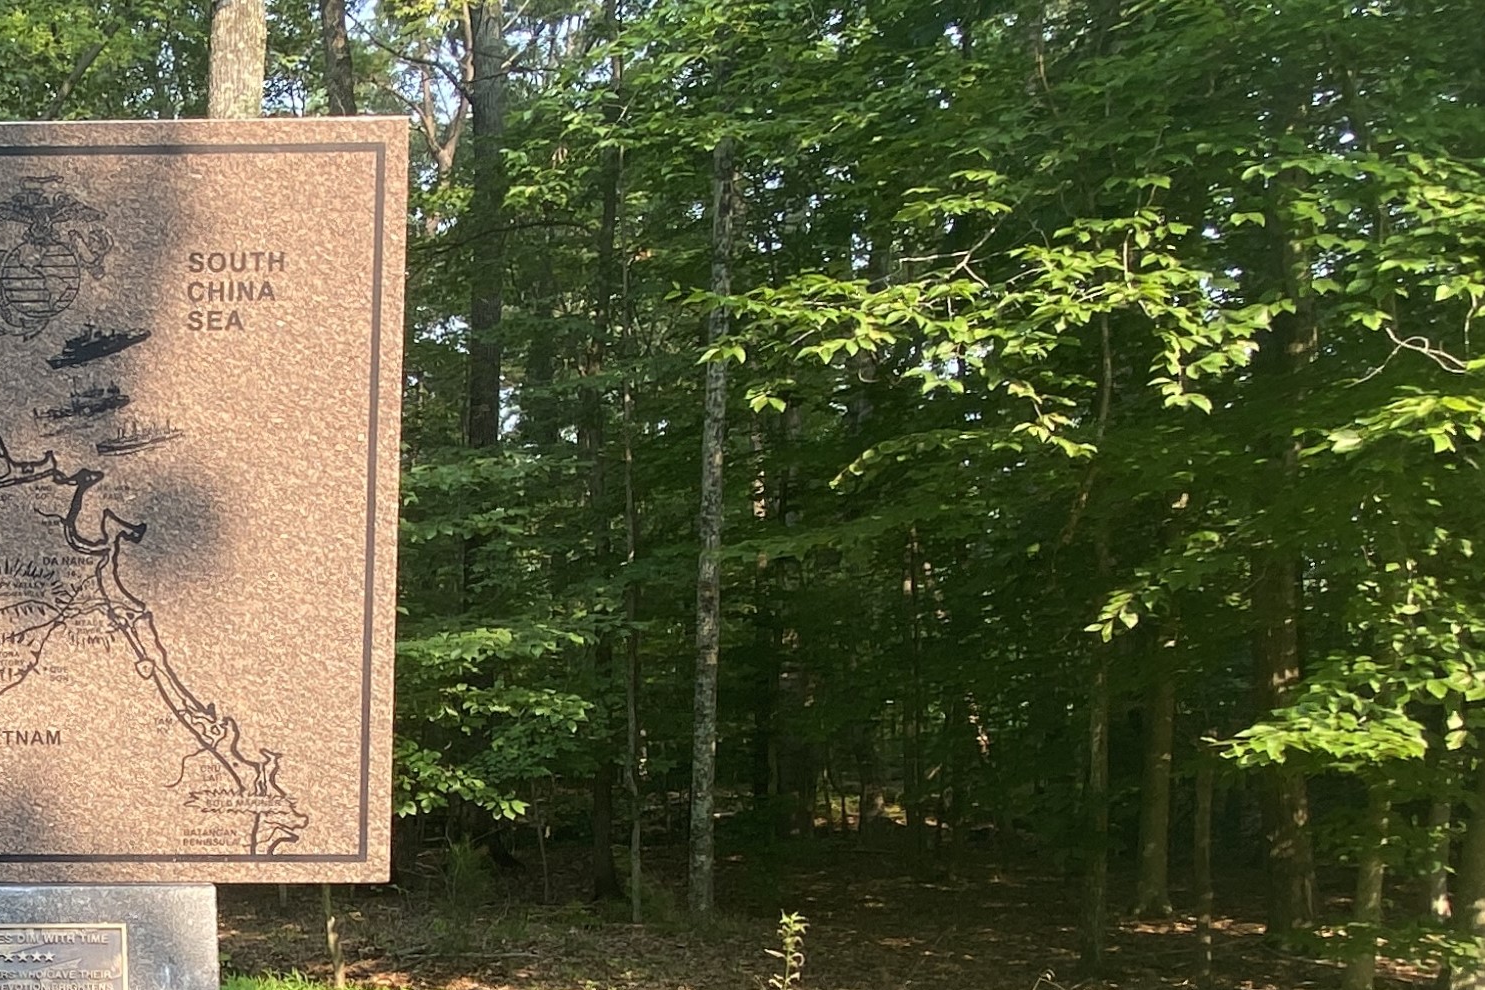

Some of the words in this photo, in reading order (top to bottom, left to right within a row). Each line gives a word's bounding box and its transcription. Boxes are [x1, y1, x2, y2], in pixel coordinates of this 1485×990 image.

[187, 251, 286, 273] SOUTH
[187, 280, 276, 302] CHINA
[187, 309, 246, 332] SEA
[42, 555, 59, 566] DA
[62, 555, 94, 566] NANG
[16, 933, 39, 945] DIM
[42, 932, 76, 944] WITH
[78, 932, 110, 944] TIME
[19, 970, 44, 980] WHO
[45, 969, 76, 980] GAVE
[81, 969, 114, 980] THEIR
